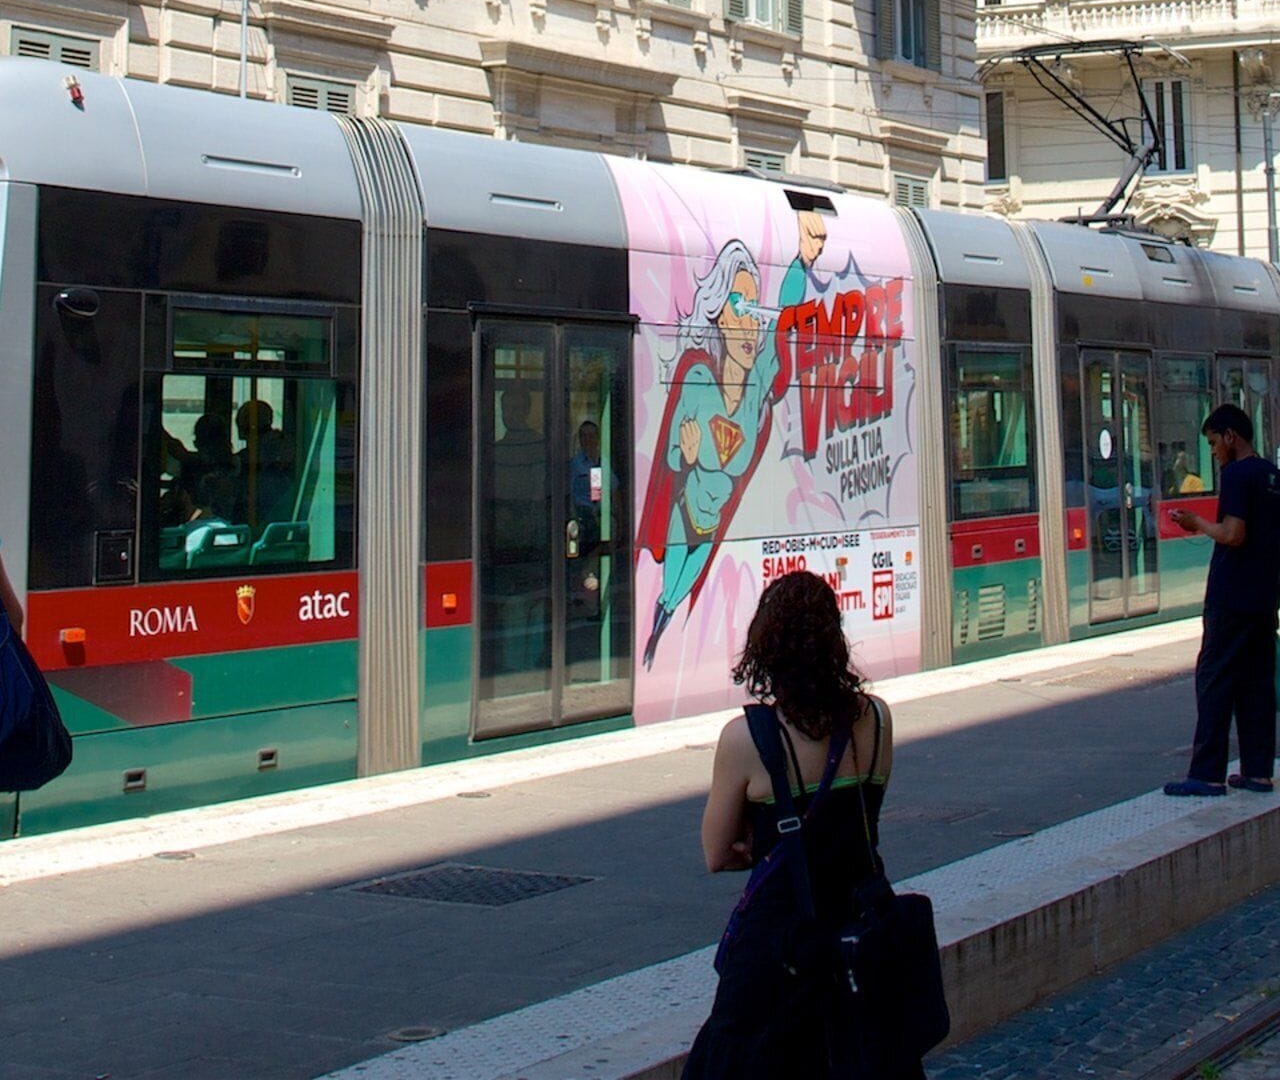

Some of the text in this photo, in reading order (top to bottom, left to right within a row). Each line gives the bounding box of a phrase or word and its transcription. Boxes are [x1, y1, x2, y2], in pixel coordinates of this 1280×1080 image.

[772, 276, 903, 406] SEMPRE
[799, 346, 894, 463] VIGILI
[825, 426, 884, 474] SULLA TUA
[839, 455, 892, 503] PENSIONE
[763, 555, 807, 578] SIAMO
[872, 551, 894, 568] CGIL
[298, 590, 351, 621] atac
[874, 586, 893, 617] SPI
[129, 605, 199, 637] ROMA
